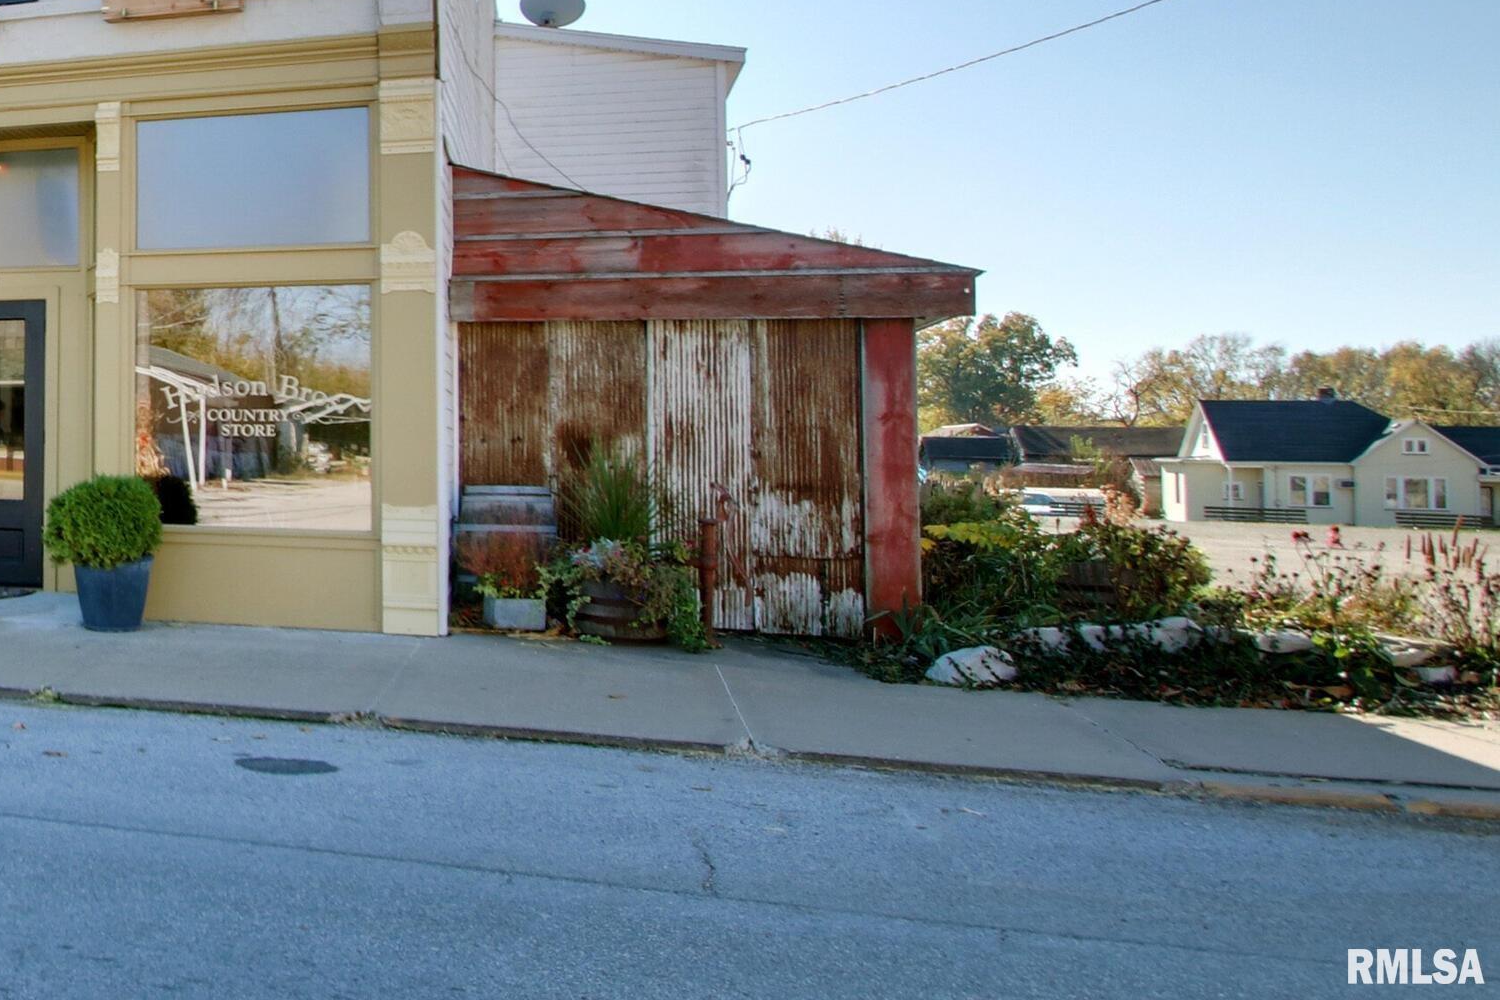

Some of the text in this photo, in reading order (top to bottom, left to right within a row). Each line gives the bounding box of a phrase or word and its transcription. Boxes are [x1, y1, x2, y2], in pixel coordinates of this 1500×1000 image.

[160, 374, 268, 410] Hdson
[207, 408, 290, 423] COUNTRY
[221, 424, 277, 438] STORE
